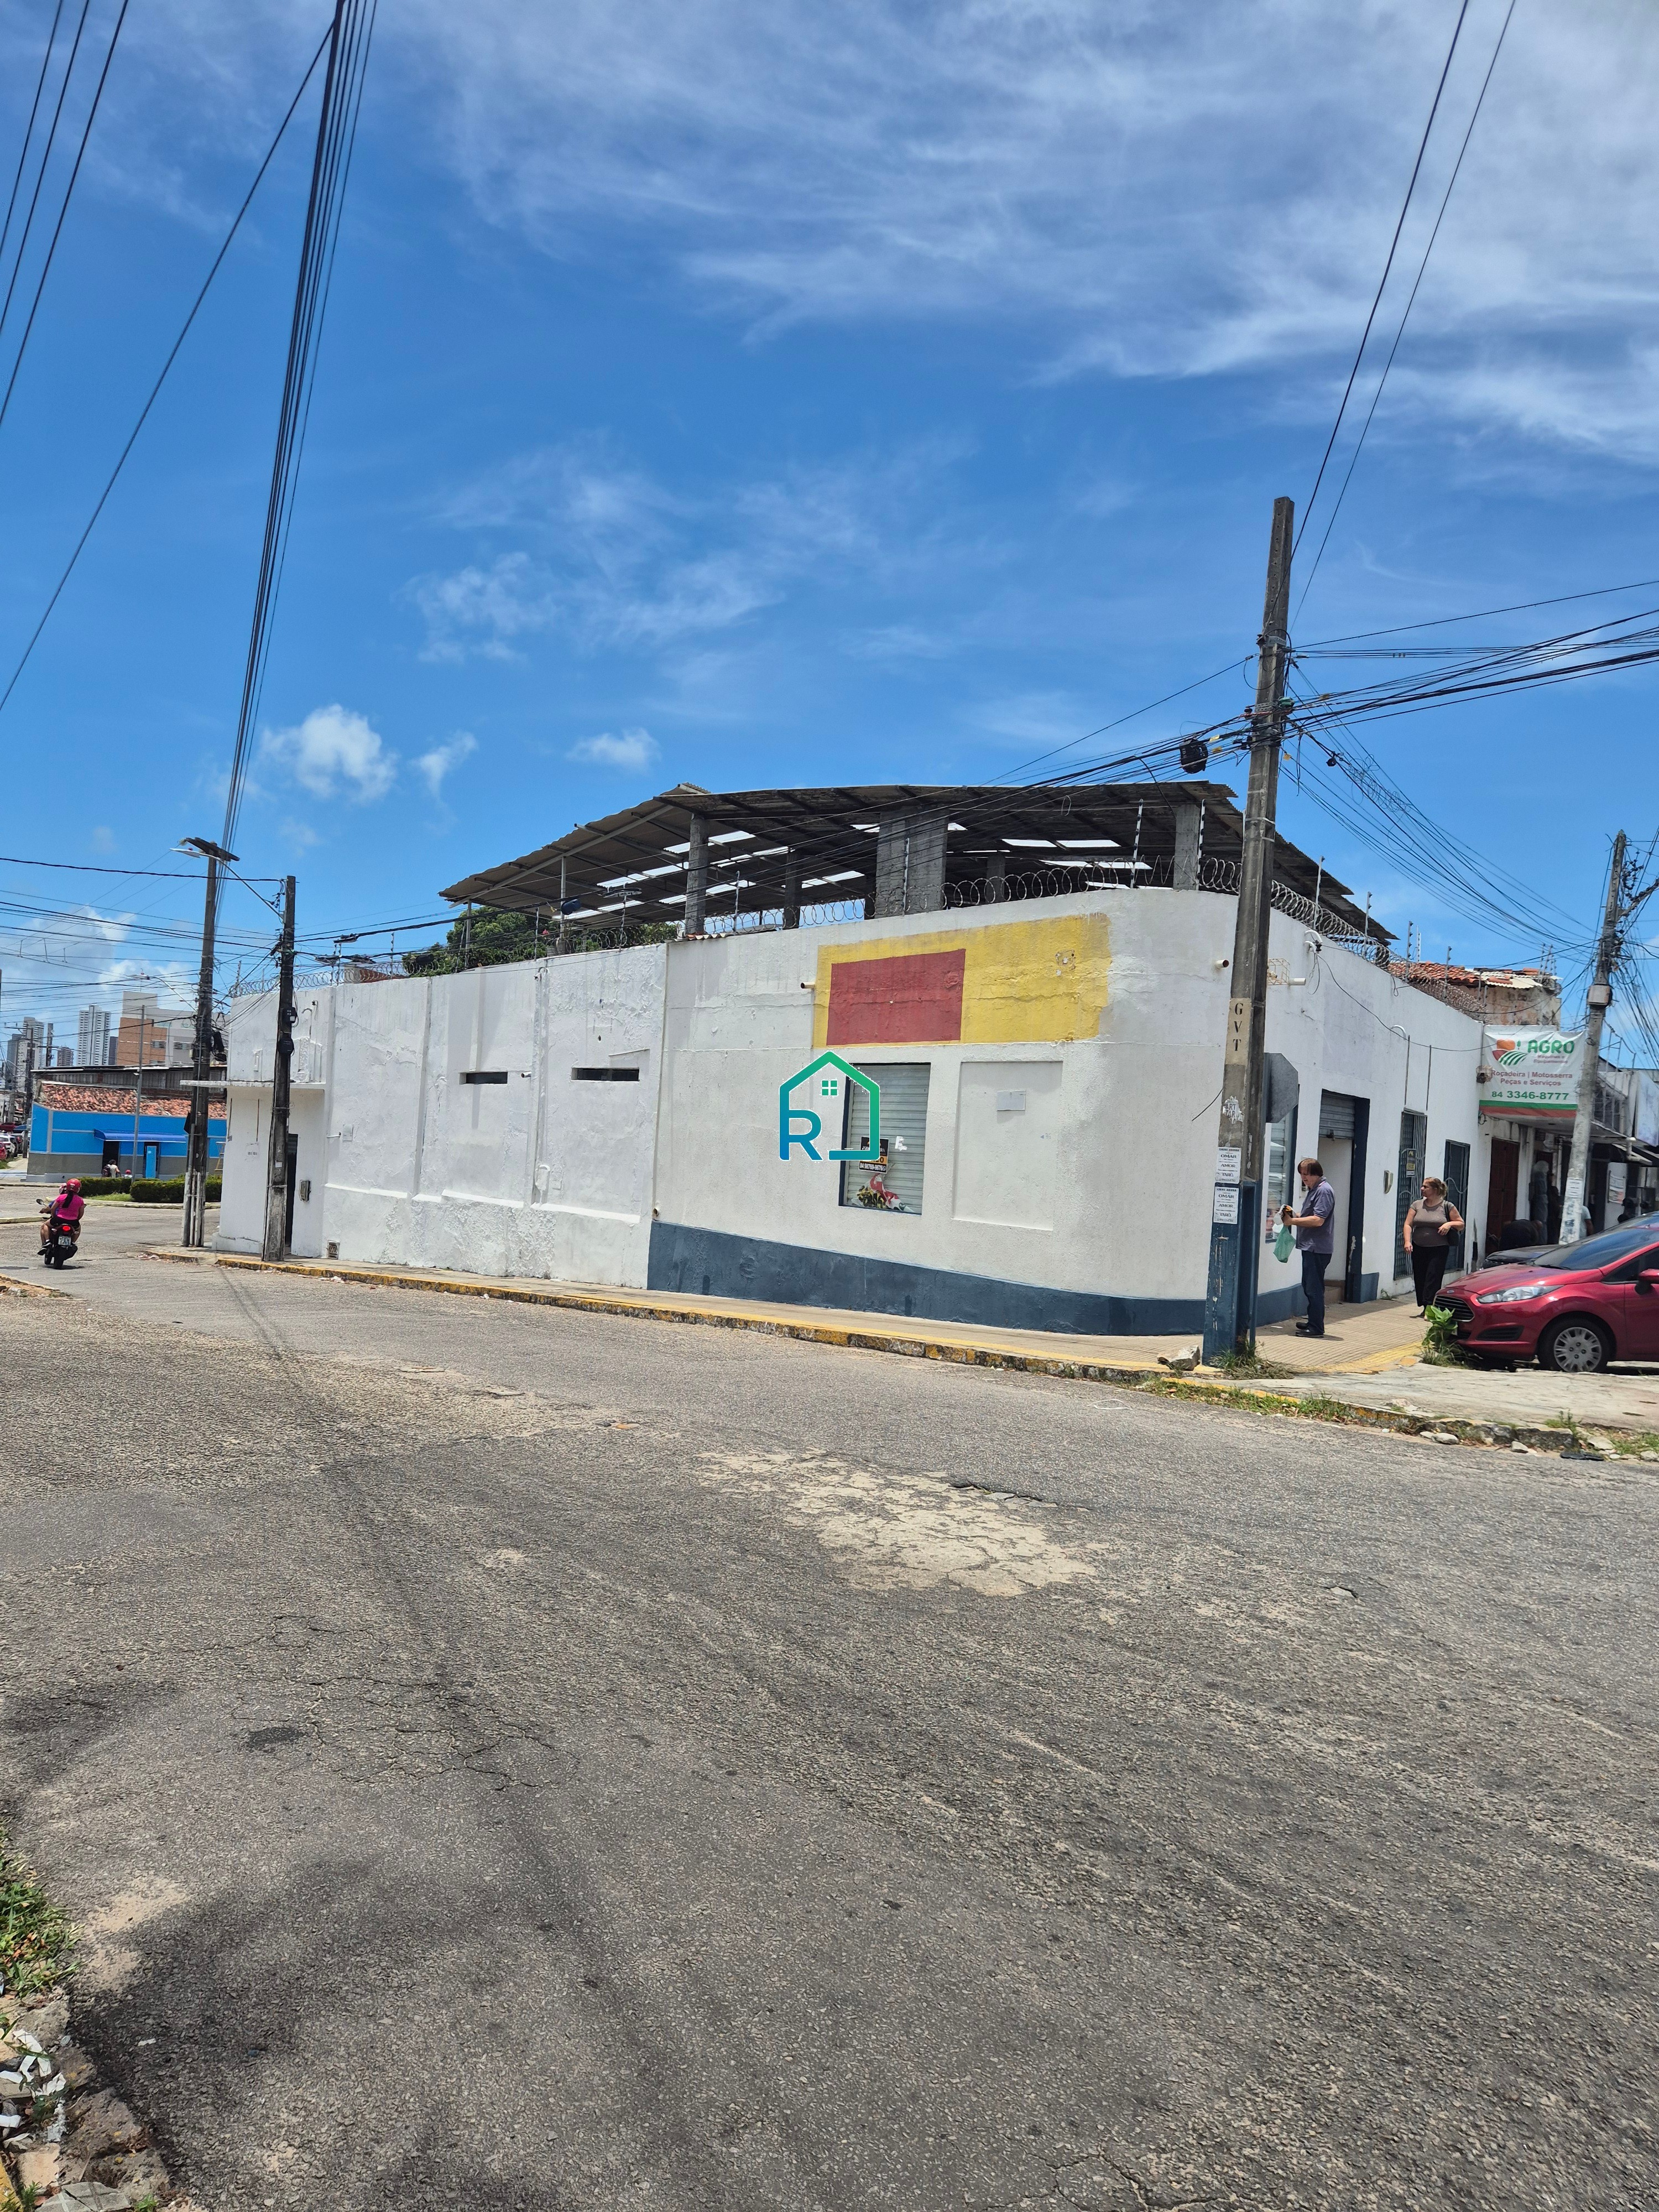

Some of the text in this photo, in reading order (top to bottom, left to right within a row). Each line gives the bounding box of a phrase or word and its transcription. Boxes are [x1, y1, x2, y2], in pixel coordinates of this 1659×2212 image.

[1232, 1002, 1244, 1052] GVT
[1527, 1039, 1575, 1054] AGRO
[1507, 1090, 1569, 1100] 3346-8777
